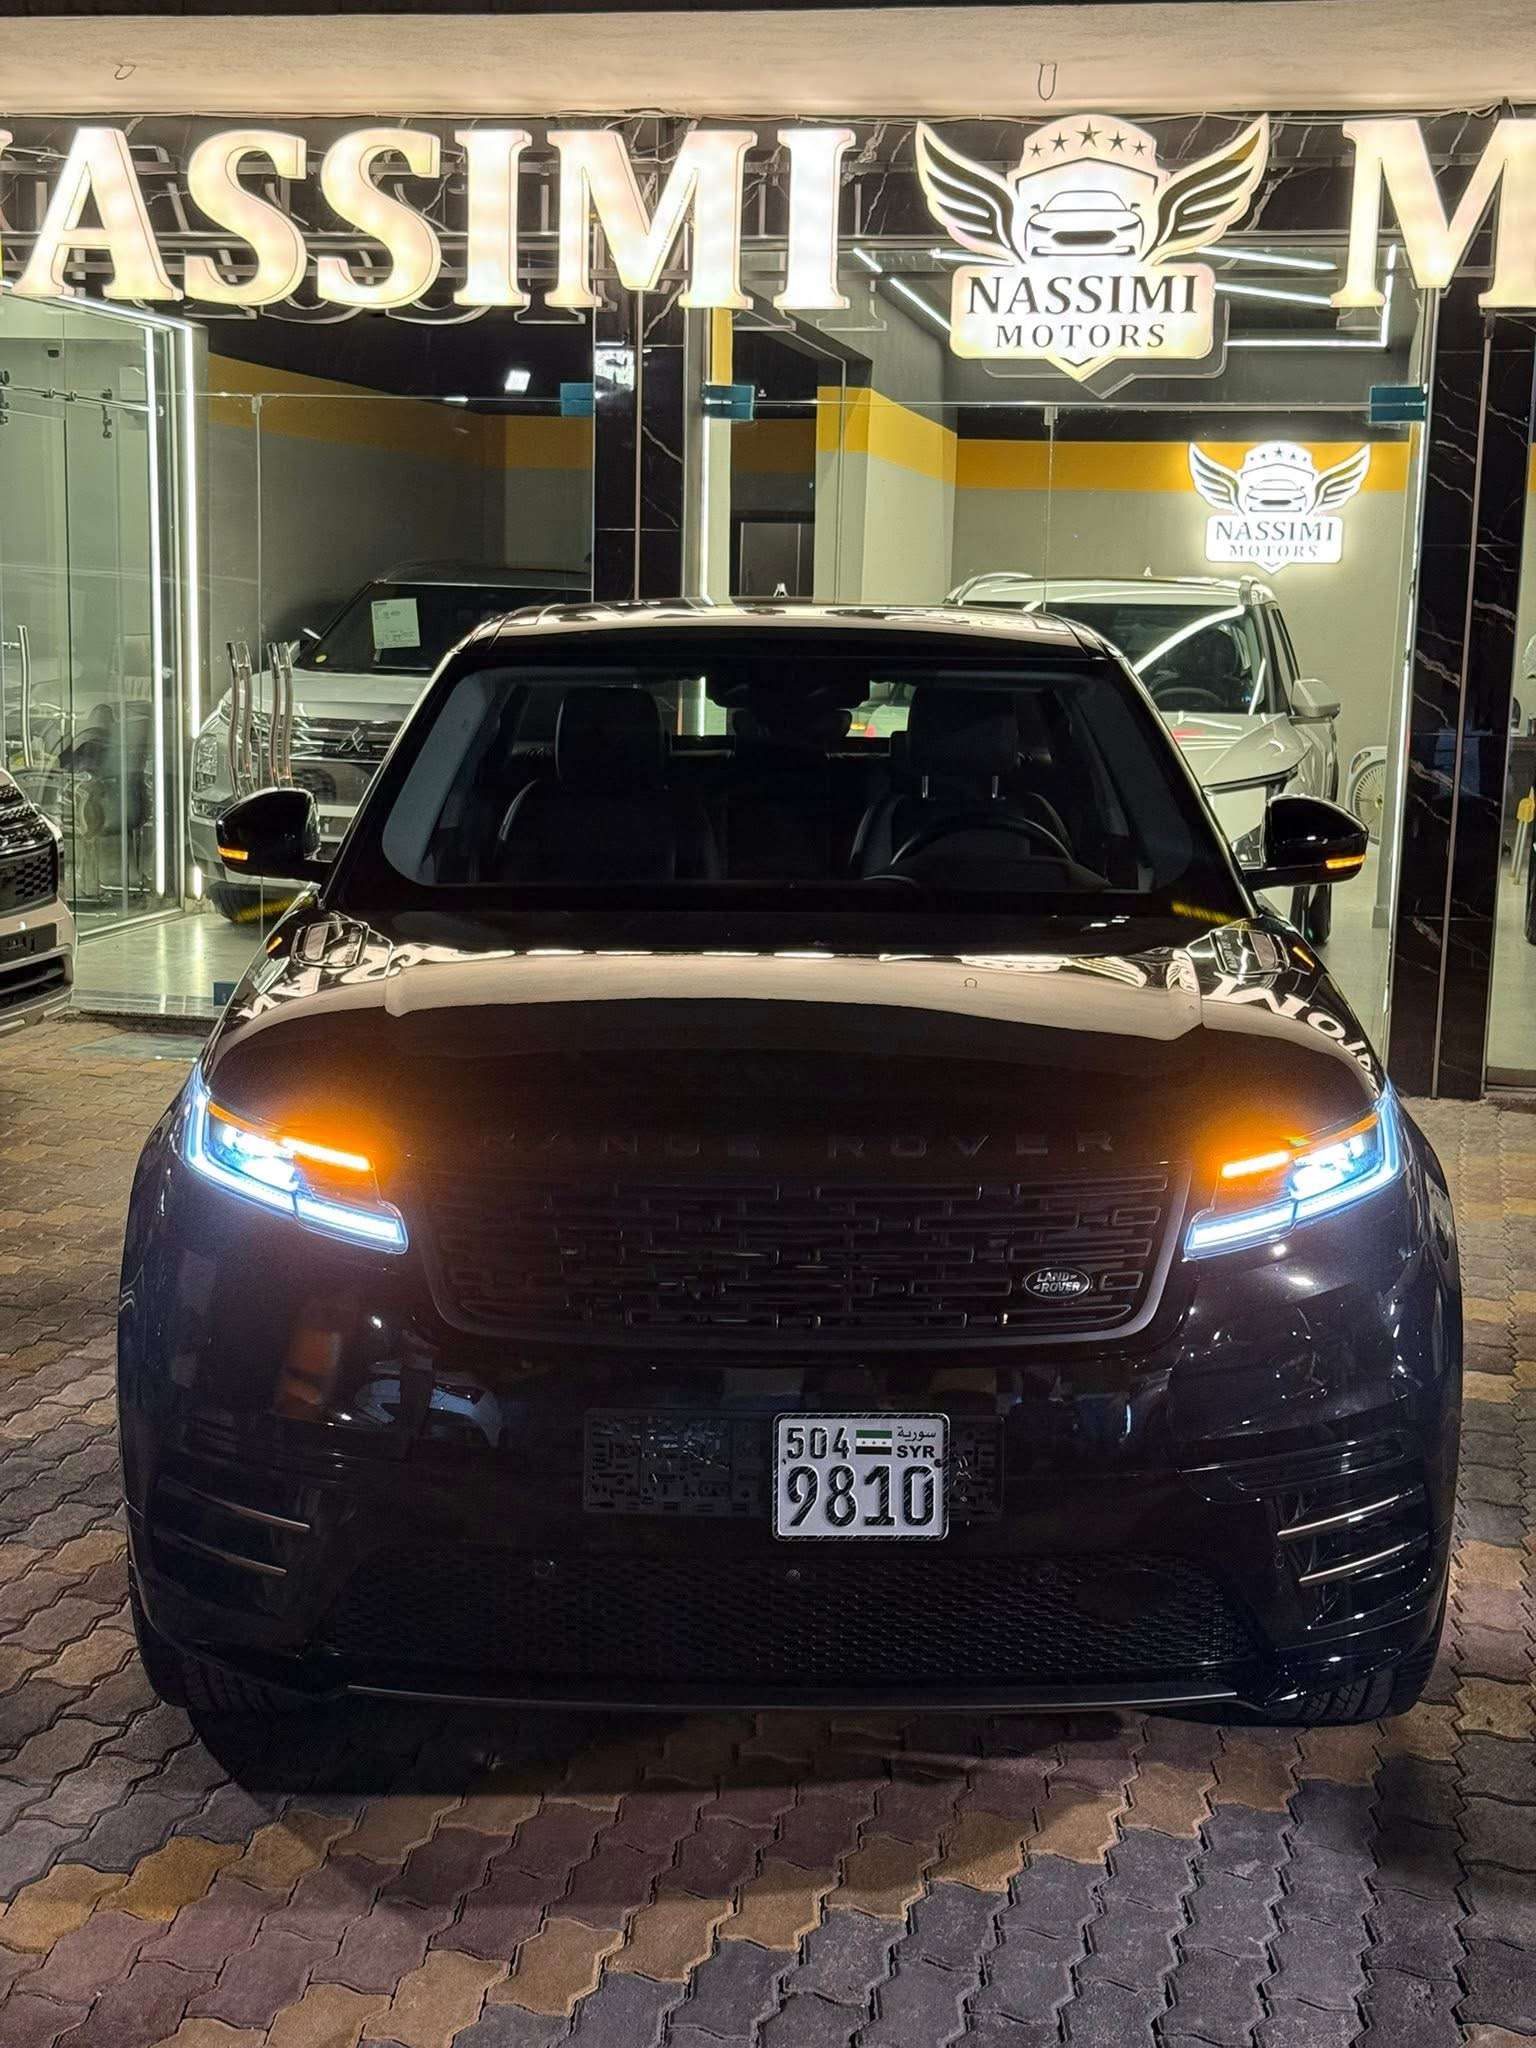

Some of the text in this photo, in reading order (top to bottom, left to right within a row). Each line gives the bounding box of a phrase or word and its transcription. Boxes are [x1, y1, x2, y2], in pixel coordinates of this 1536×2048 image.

[0, 126, 856, 312] ASSIMI
[967, 275, 1199, 315] NASSIMI
[996, 323, 1166, 348] MOTORS
[1216, 520, 1333, 541] NASSIMI
[1229, 544, 1319, 557] MOTORS
[1037, 1271, 1070, 1282] LAND
[1040, 1281, 1081, 1293] ROVER
[787, 1426, 851, 1460] 504
[897, 1426, 937, 1442] سورية
[896, 1445, 936, 1459] SYR
[787, 1464, 937, 1527] 9810
